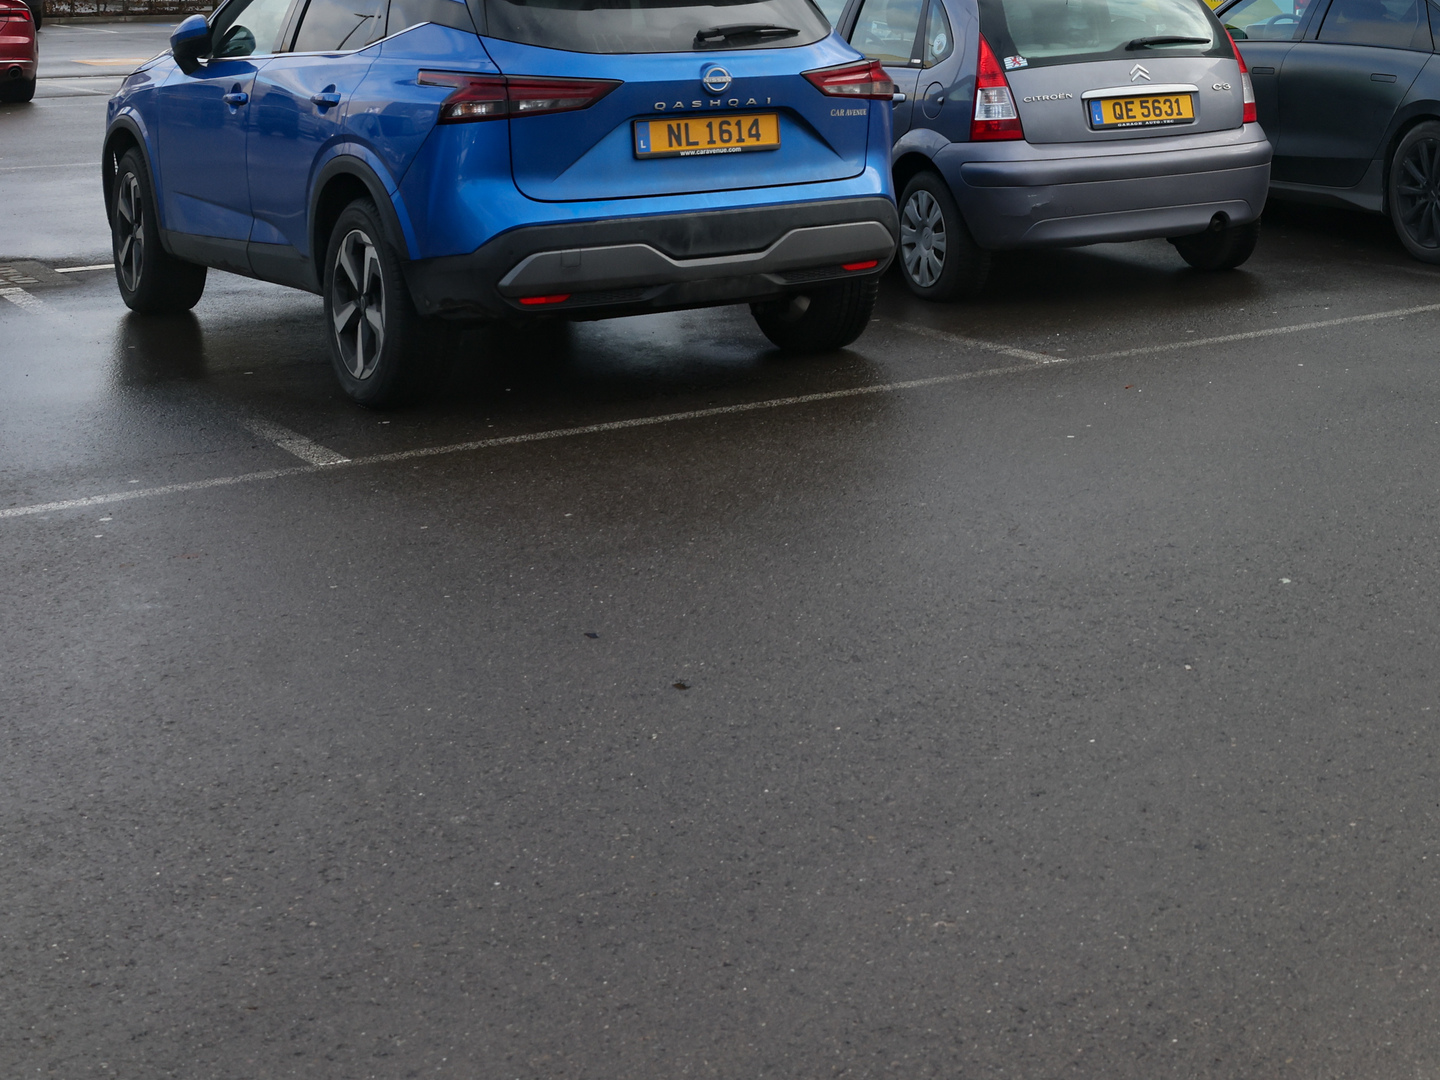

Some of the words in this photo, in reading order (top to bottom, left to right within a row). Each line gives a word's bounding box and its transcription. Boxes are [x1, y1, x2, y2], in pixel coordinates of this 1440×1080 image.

[1212, 82, 1232, 91] C3
[654, 97, 771, 111] QASHQAI
[1023, 92, 1073, 104] CITROËN
[830, 108, 845, 117] CAR
[845, 107, 867, 116] AVENUE
[1095, 114, 1100, 122] L
[1112, 100, 1136, 120] QE
[1140, 98, 1183, 119] 5631
[640, 140, 646, 149] L
[667, 122, 699, 148] NL
[705, 118, 761, 144] 1614
[679, 147, 742, 157] www.caravenue.com
